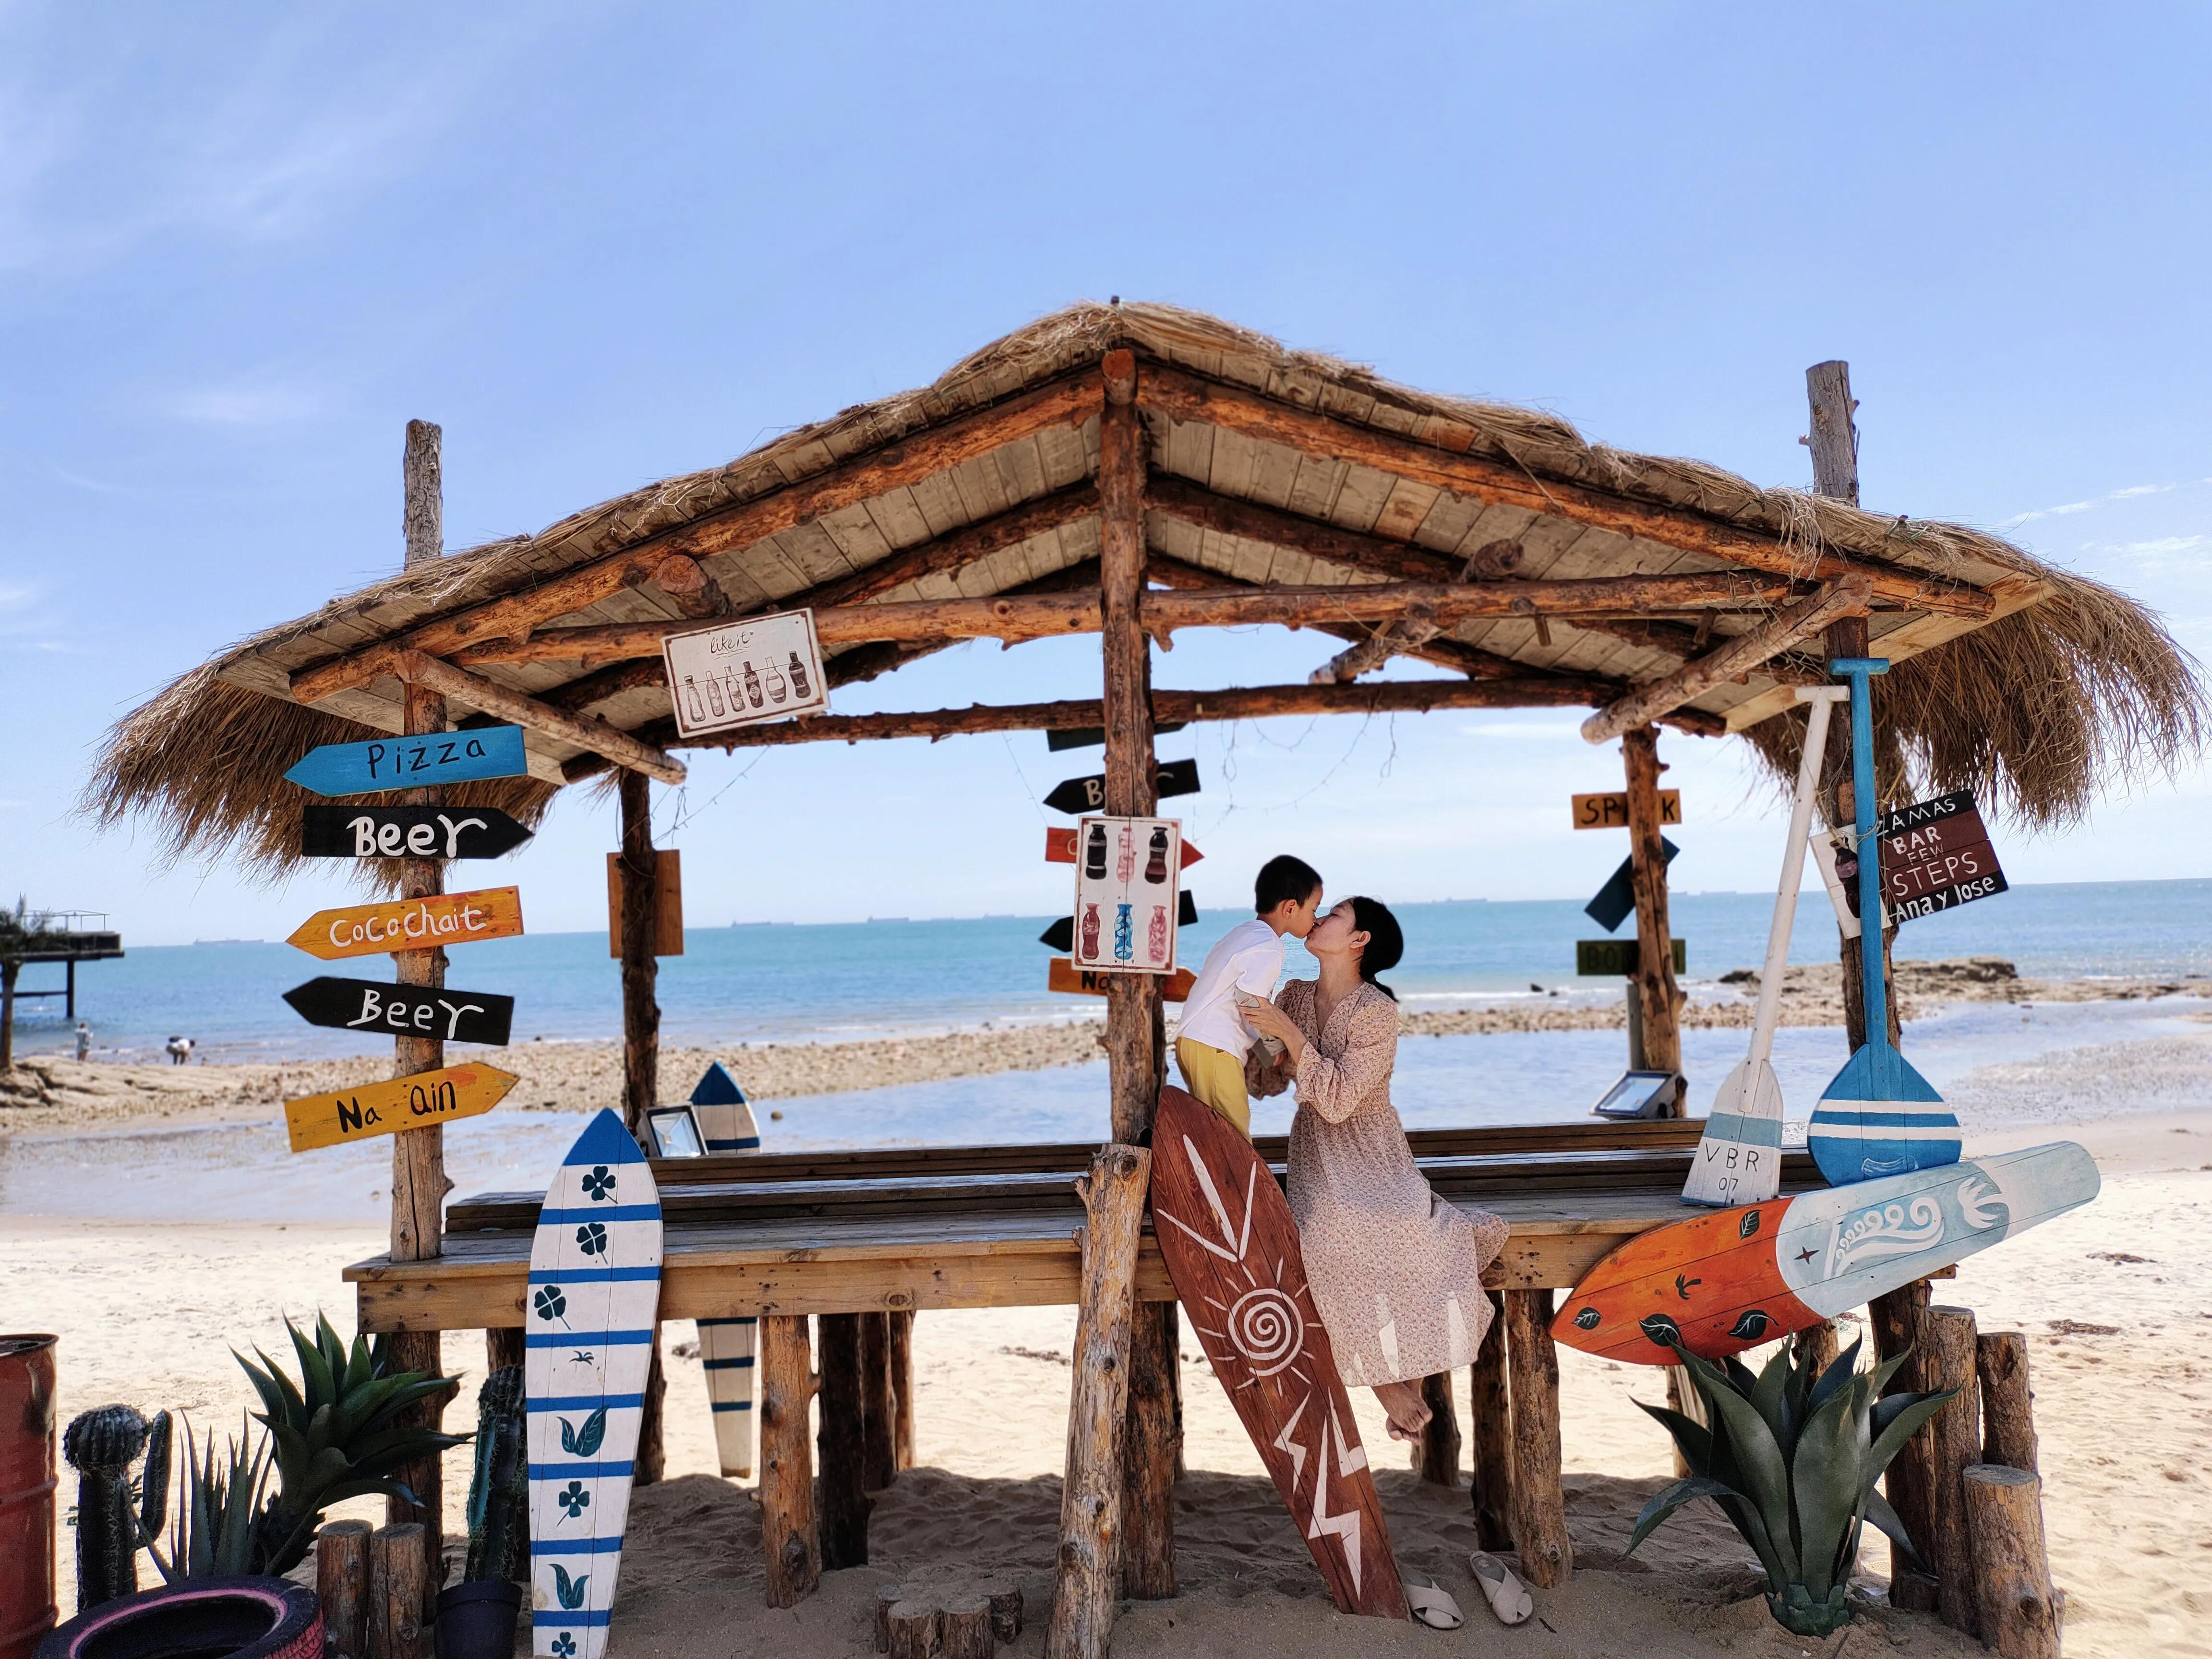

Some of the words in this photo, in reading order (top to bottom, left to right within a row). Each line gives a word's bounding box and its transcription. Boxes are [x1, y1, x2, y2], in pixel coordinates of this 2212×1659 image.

[367, 739, 486, 779] Pizza
[346, 814, 488, 858] Beer
[1892, 826, 1942, 854] BAR
[1907, 842, 1944, 866] FEW
[1893, 852, 1978, 897] STEPS
[346, 989, 484, 1039] Beer
[1719, 1177, 1738, 1191] 07
